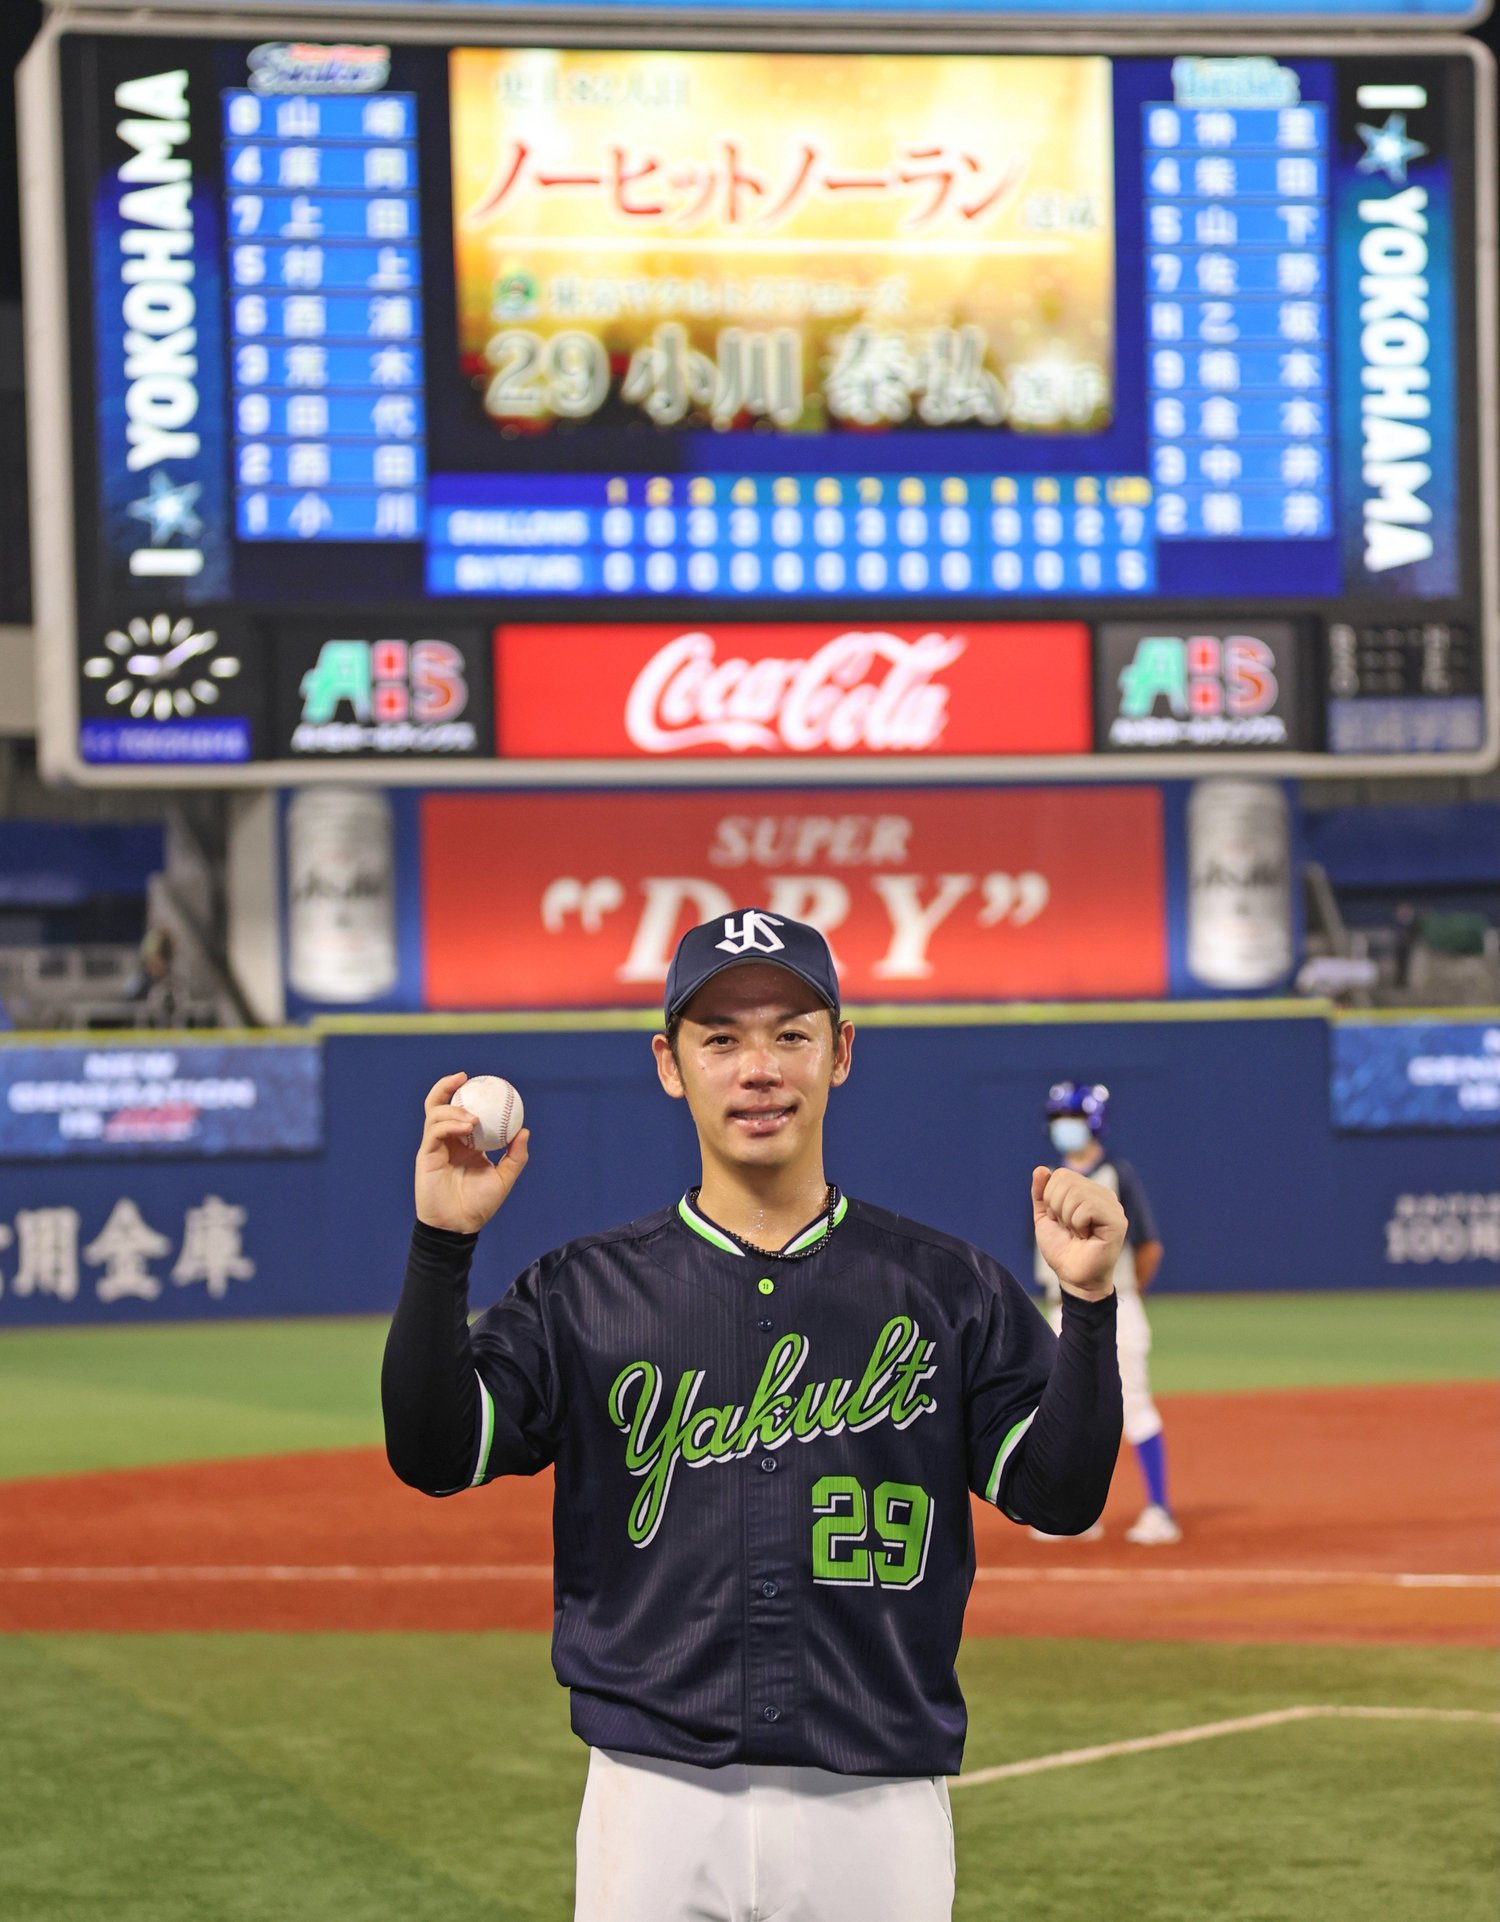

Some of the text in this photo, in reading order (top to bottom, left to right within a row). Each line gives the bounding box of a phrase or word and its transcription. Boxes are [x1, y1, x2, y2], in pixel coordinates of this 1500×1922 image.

[232, 196, 261, 234] 7
[468, 138, 1026, 230] ノーヒットノーラン
[115, 69, 200, 472] YOKOHAMA
[485, 330, 609, 418] 29
[622, 322, 804, 424] 小川
[1358, 186, 1433, 573] YOKOHAMA
[709, 815, 912, 866] SUPER
[0, 1196, 256, 1300] 用金庫
[608, 1315, 937, 1549] Yakult
[811, 1475, 935, 1591] 29
